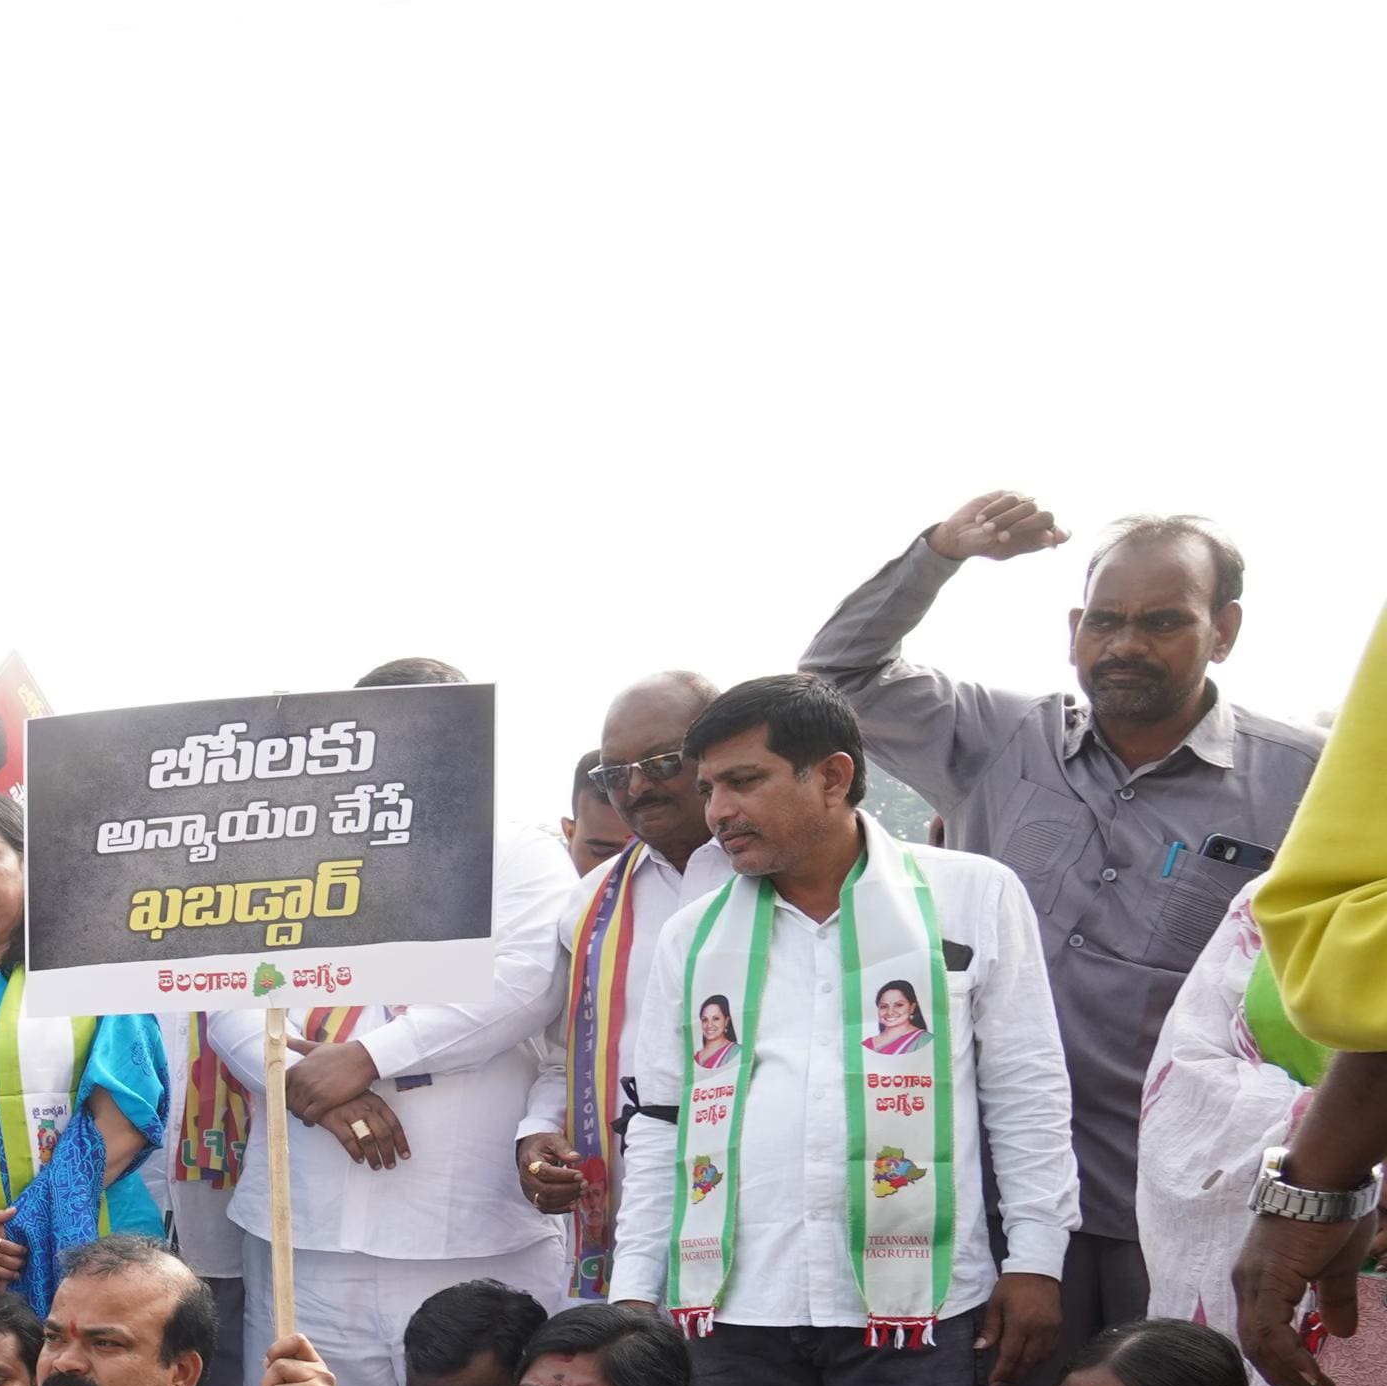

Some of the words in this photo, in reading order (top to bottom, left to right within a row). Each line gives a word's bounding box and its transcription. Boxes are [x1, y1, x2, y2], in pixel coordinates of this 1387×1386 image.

[147, 721, 376, 790] బీసీలకు
[96, 799, 316, 863] అన్యాయం
[329, 782, 414, 847] చేస్తే
[129, 859, 364, 947] ఖబడ్దార్
[157, 969, 248, 993] తెలంగాణ
[292, 961, 353, 993] జాగృతి
[867, 1073, 933, 1092] తెలంగాణ
[866, 1248, 929, 1260] JAGRUTHI
[868, 1235, 929, 1246] TELANGANA
